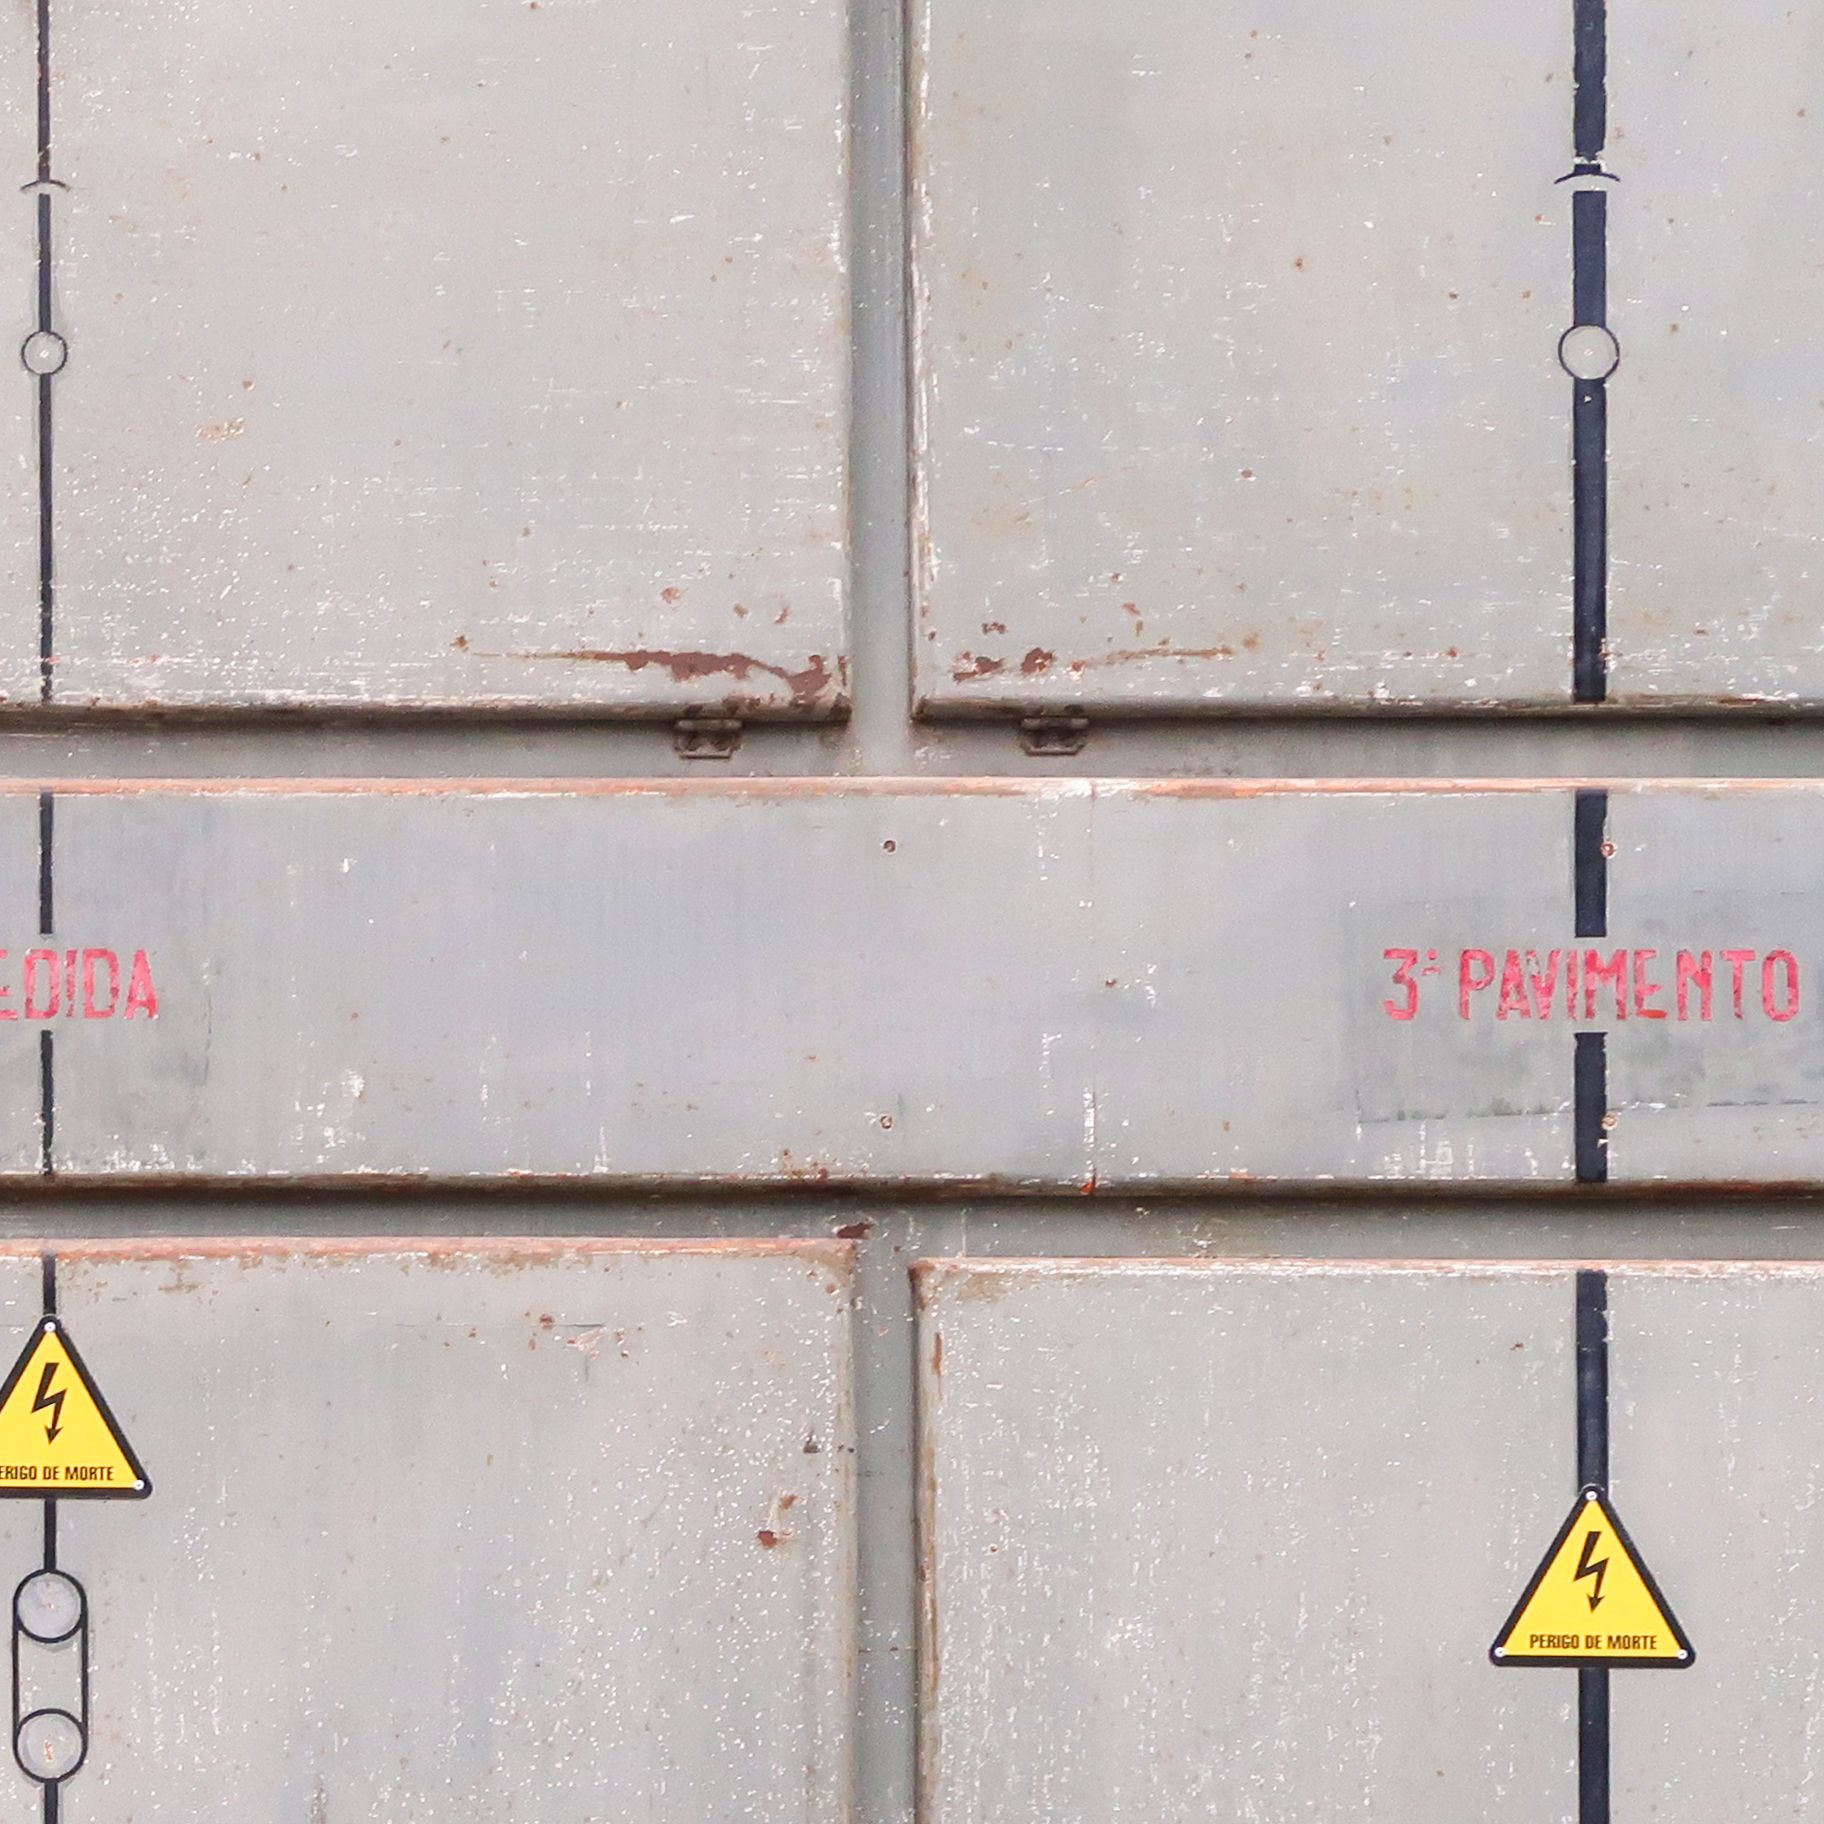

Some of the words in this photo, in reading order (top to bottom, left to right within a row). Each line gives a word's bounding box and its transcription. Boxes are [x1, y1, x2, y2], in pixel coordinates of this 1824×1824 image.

[1458, 948, 1801, 1022] PAVIMENTO
[42, 1465, 60, 1481] DE
[64, 1465, 114, 1481] MORTE
[1529, 1633, 1580, 1650] PERIGO
[1585, 1634, 1602, 1650] DE
[1607, 1634, 1658, 1651] MORTE
